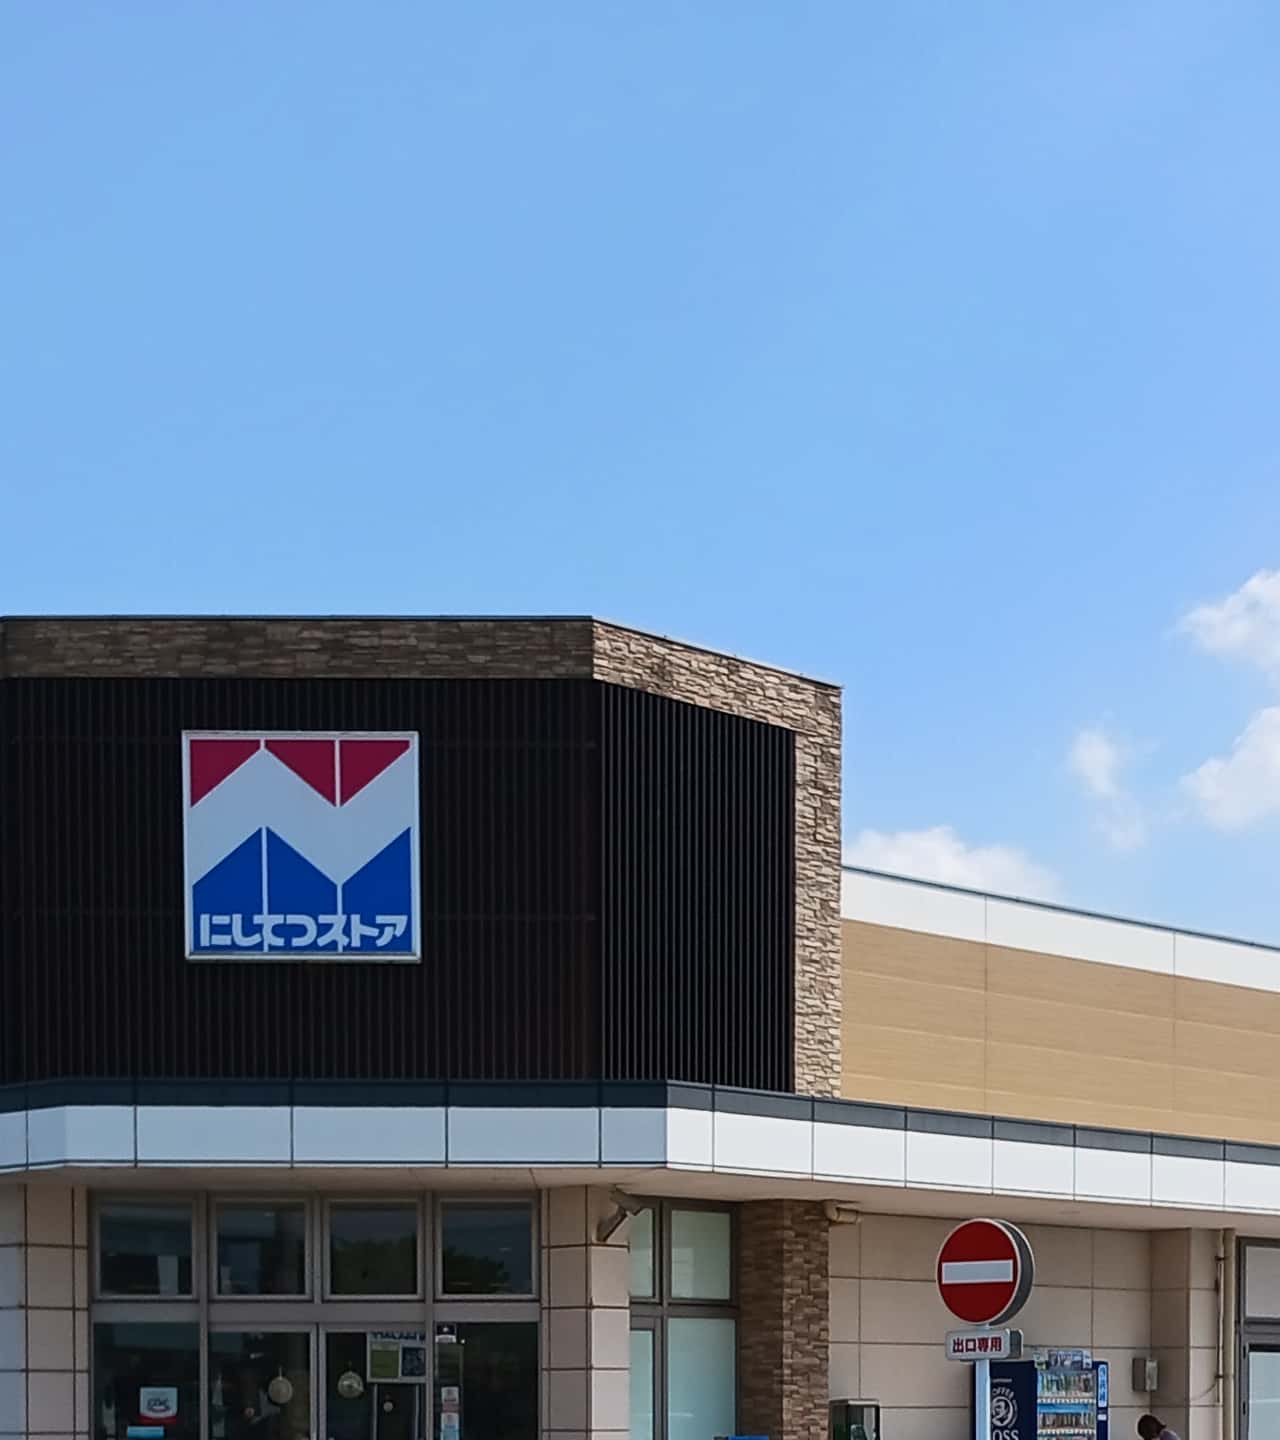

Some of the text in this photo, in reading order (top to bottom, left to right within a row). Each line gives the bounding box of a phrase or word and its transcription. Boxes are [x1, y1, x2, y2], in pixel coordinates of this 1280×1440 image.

[199, 913, 409, 948] にしてつストア
[952, 1337, 1002, 1353] 出口専用
